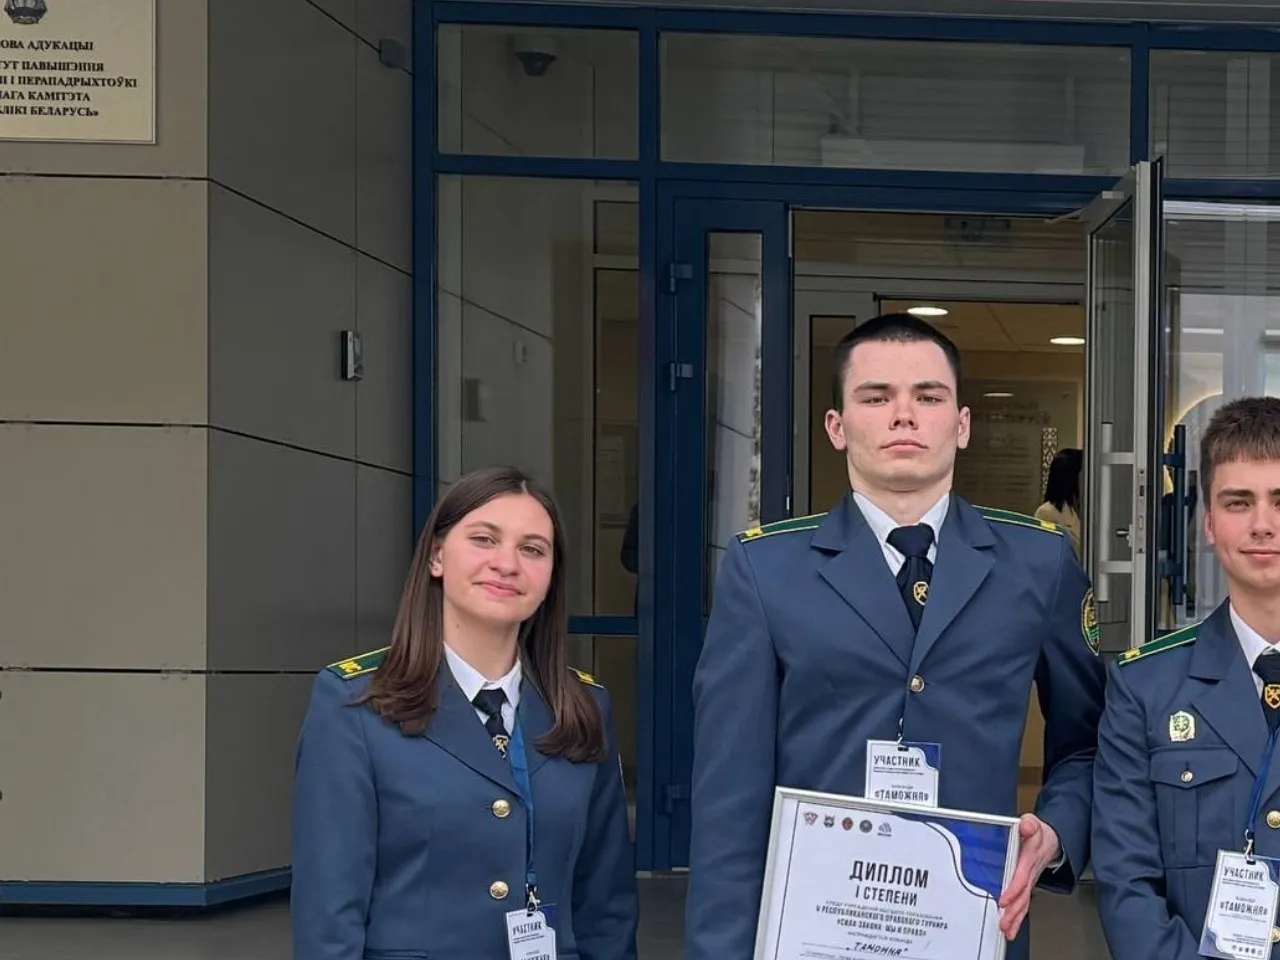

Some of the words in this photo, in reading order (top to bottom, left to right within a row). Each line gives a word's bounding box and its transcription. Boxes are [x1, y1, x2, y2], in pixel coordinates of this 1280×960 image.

[27, 40, 94, 51] АДУКАЦЫІ
[22, 61, 105, 72] ПАВЫШЭННЯ
[18, 76, 137, 88] ПЕРАПАДРЫХТОЎКІ
[28, 91, 91, 102] КАМІТЭТА
[30, 106, 99, 117] БЕЛАРУСЬ»
[874, 755, 920, 767] УЧАСТНИК
[849, 860, 929, 889] ДИПЛОМ
[1224, 866, 1264, 882] УЧАСТНИК
[863, 886, 918, 907] СТЕПЕНИ
